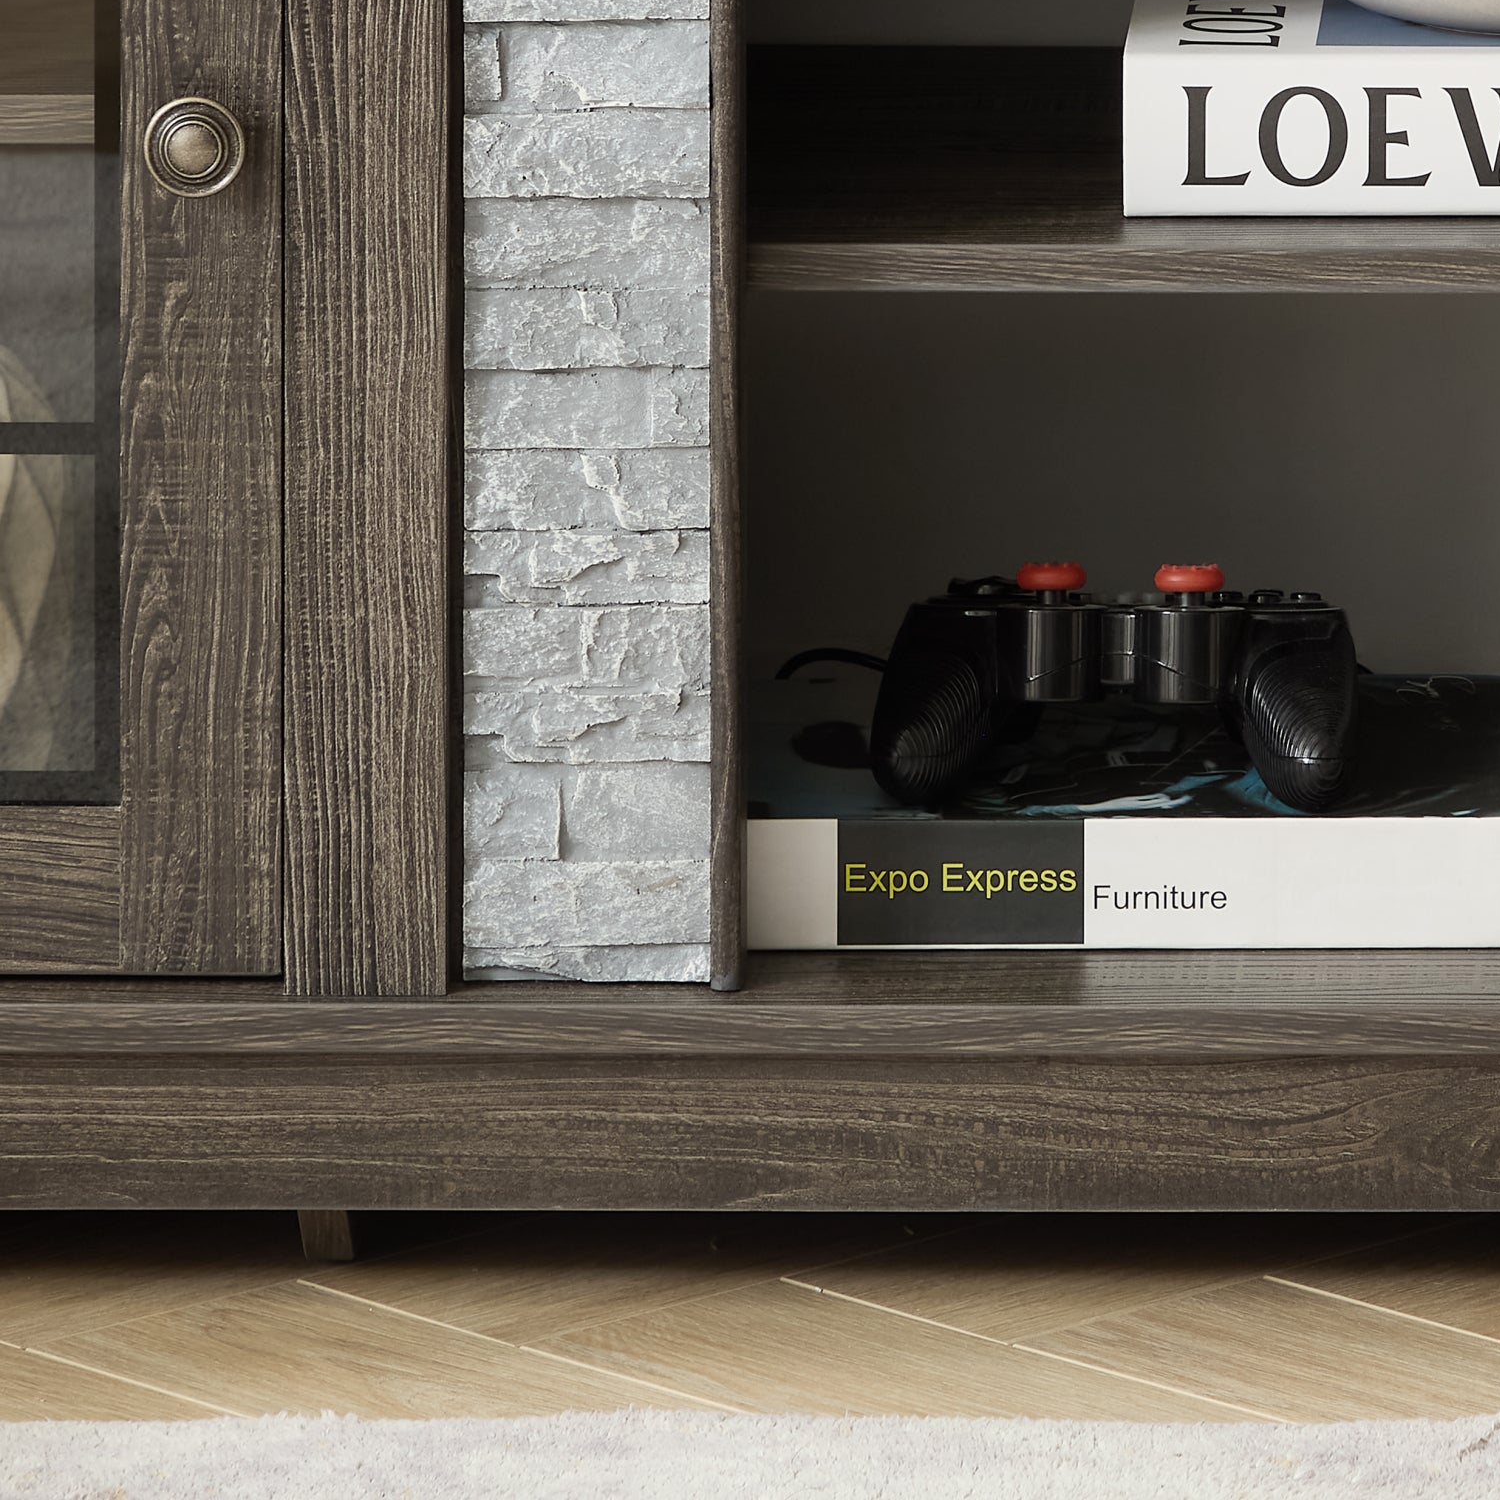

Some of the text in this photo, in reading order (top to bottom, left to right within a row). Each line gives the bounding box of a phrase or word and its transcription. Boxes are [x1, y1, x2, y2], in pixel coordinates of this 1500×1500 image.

[845, 862, 1077, 900] Expo Express
[1093, 884, 1227, 910] Furniture
